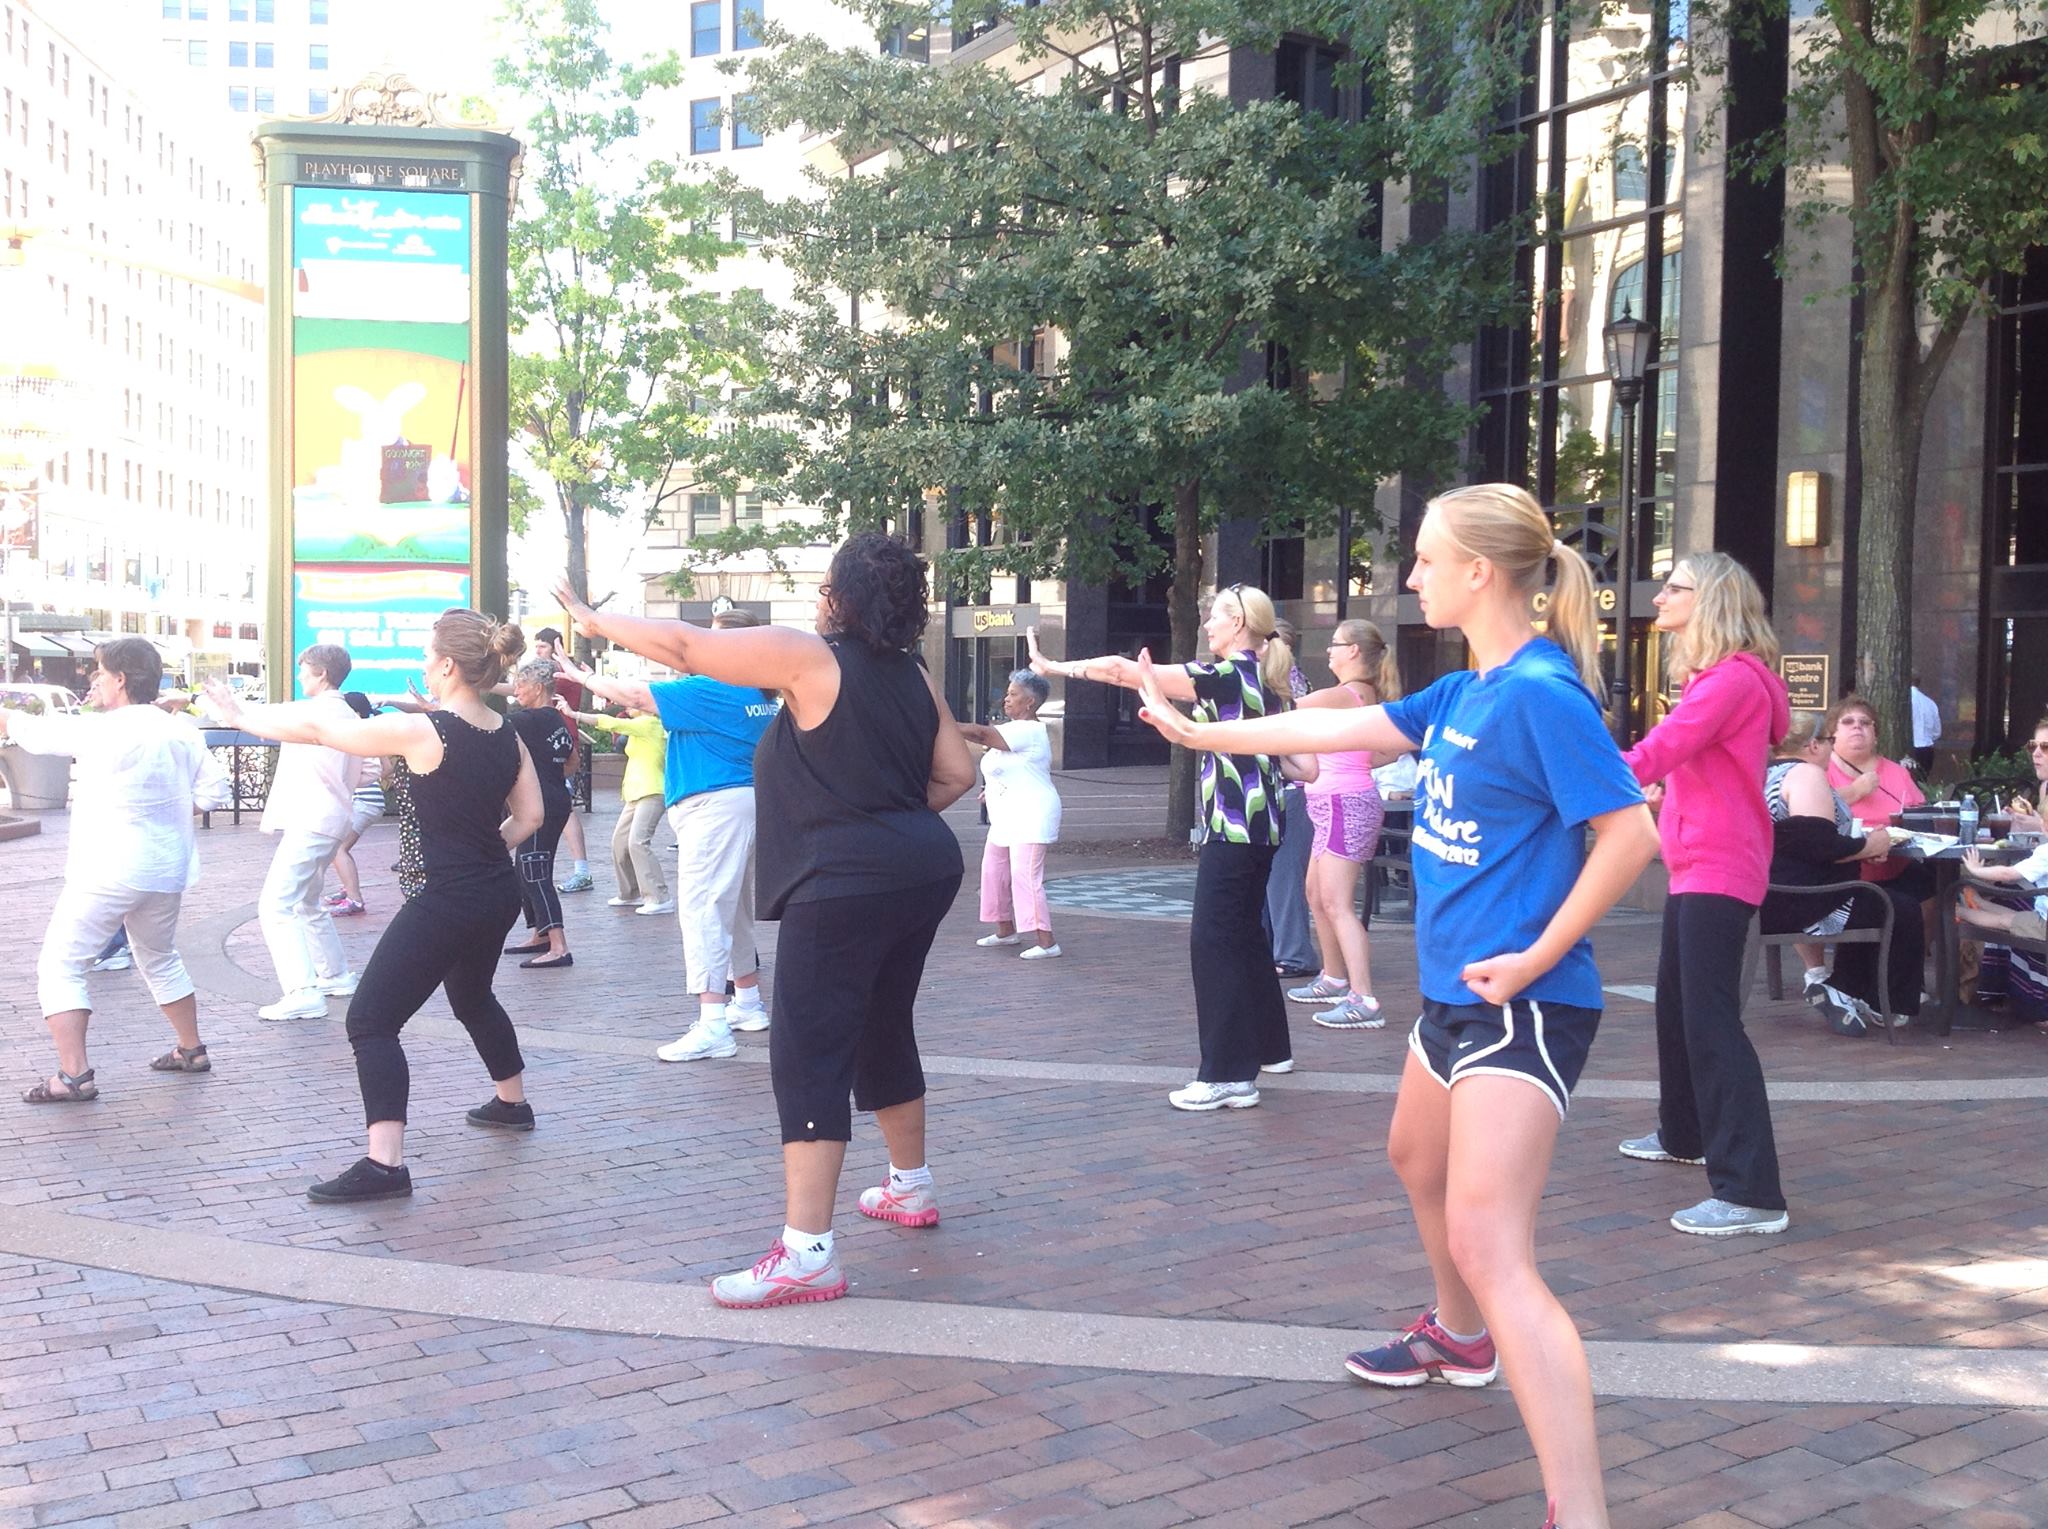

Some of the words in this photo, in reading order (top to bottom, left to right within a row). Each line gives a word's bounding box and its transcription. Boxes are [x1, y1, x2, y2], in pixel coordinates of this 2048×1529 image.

[305, 162, 393, 178] PLAYHOUSE
[399, 166, 458, 180] SQUARE
[1788, 674, 1820, 682] centre
